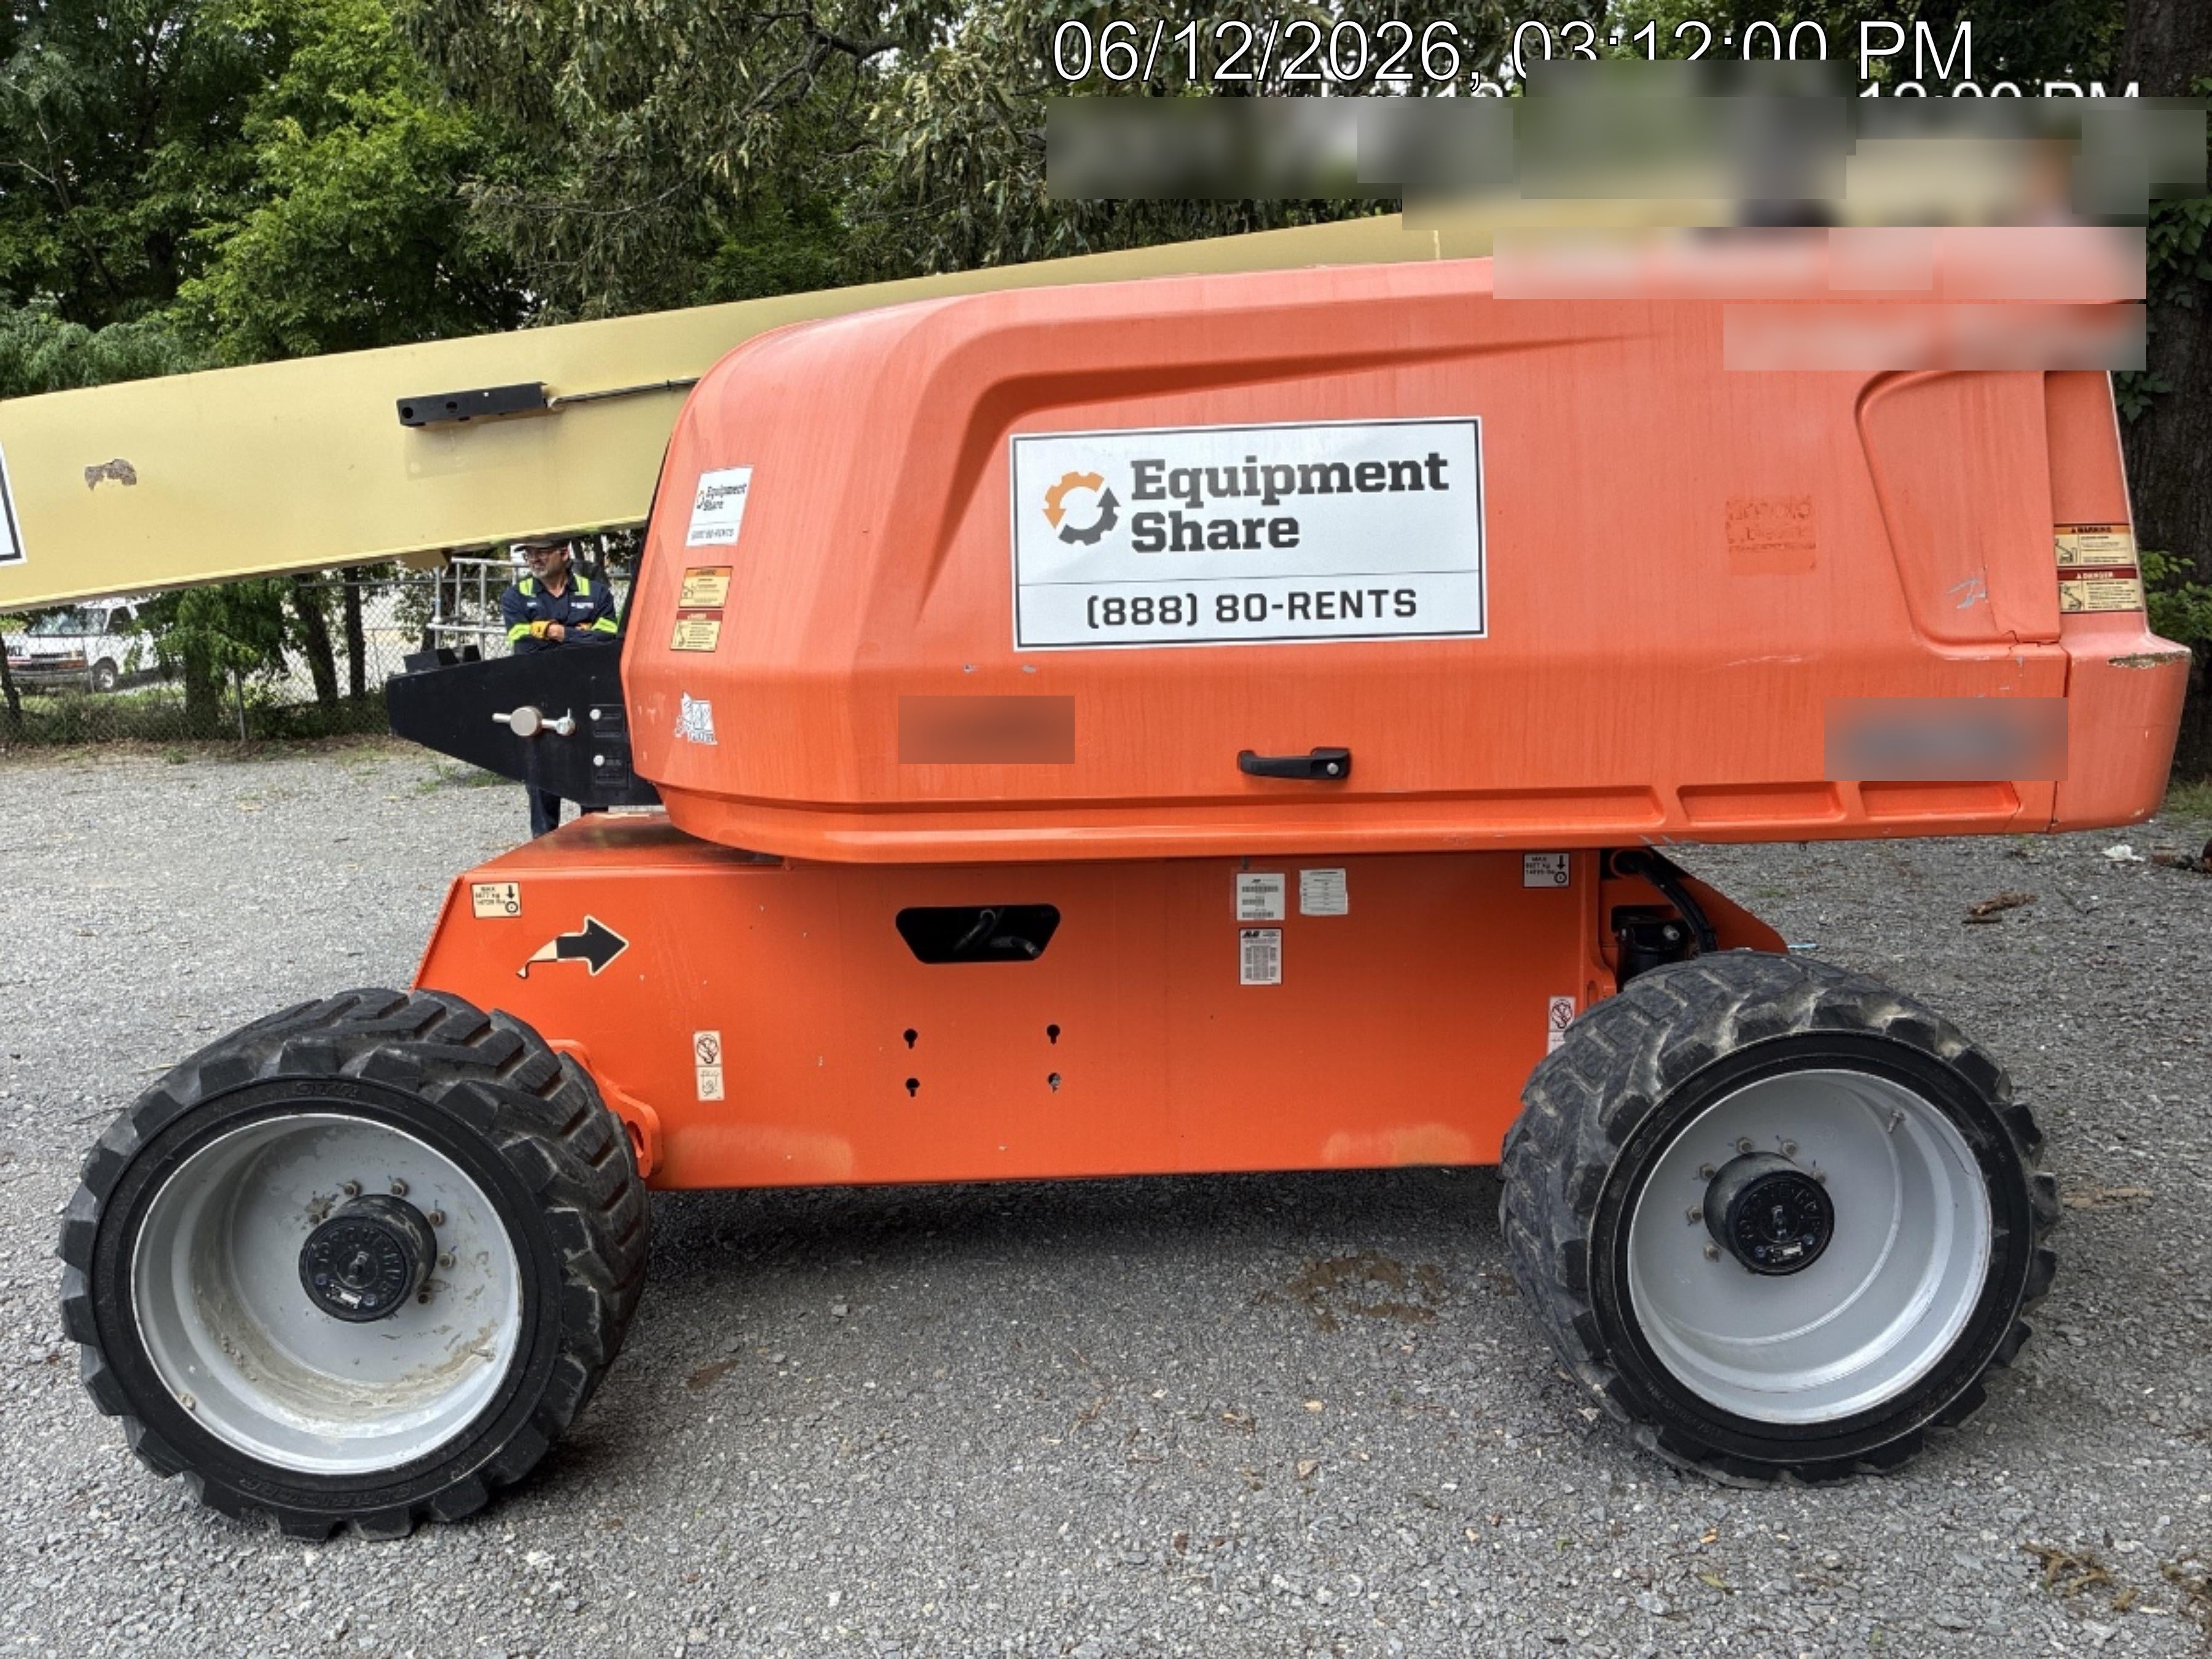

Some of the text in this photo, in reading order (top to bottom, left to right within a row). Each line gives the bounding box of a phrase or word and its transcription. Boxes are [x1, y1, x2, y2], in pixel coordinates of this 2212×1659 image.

[1131, 452, 1449, 509] Equipment
[1131, 510, 1300, 553] Share
[1087, 588, 1418, 629] (888) 80-RENTS
